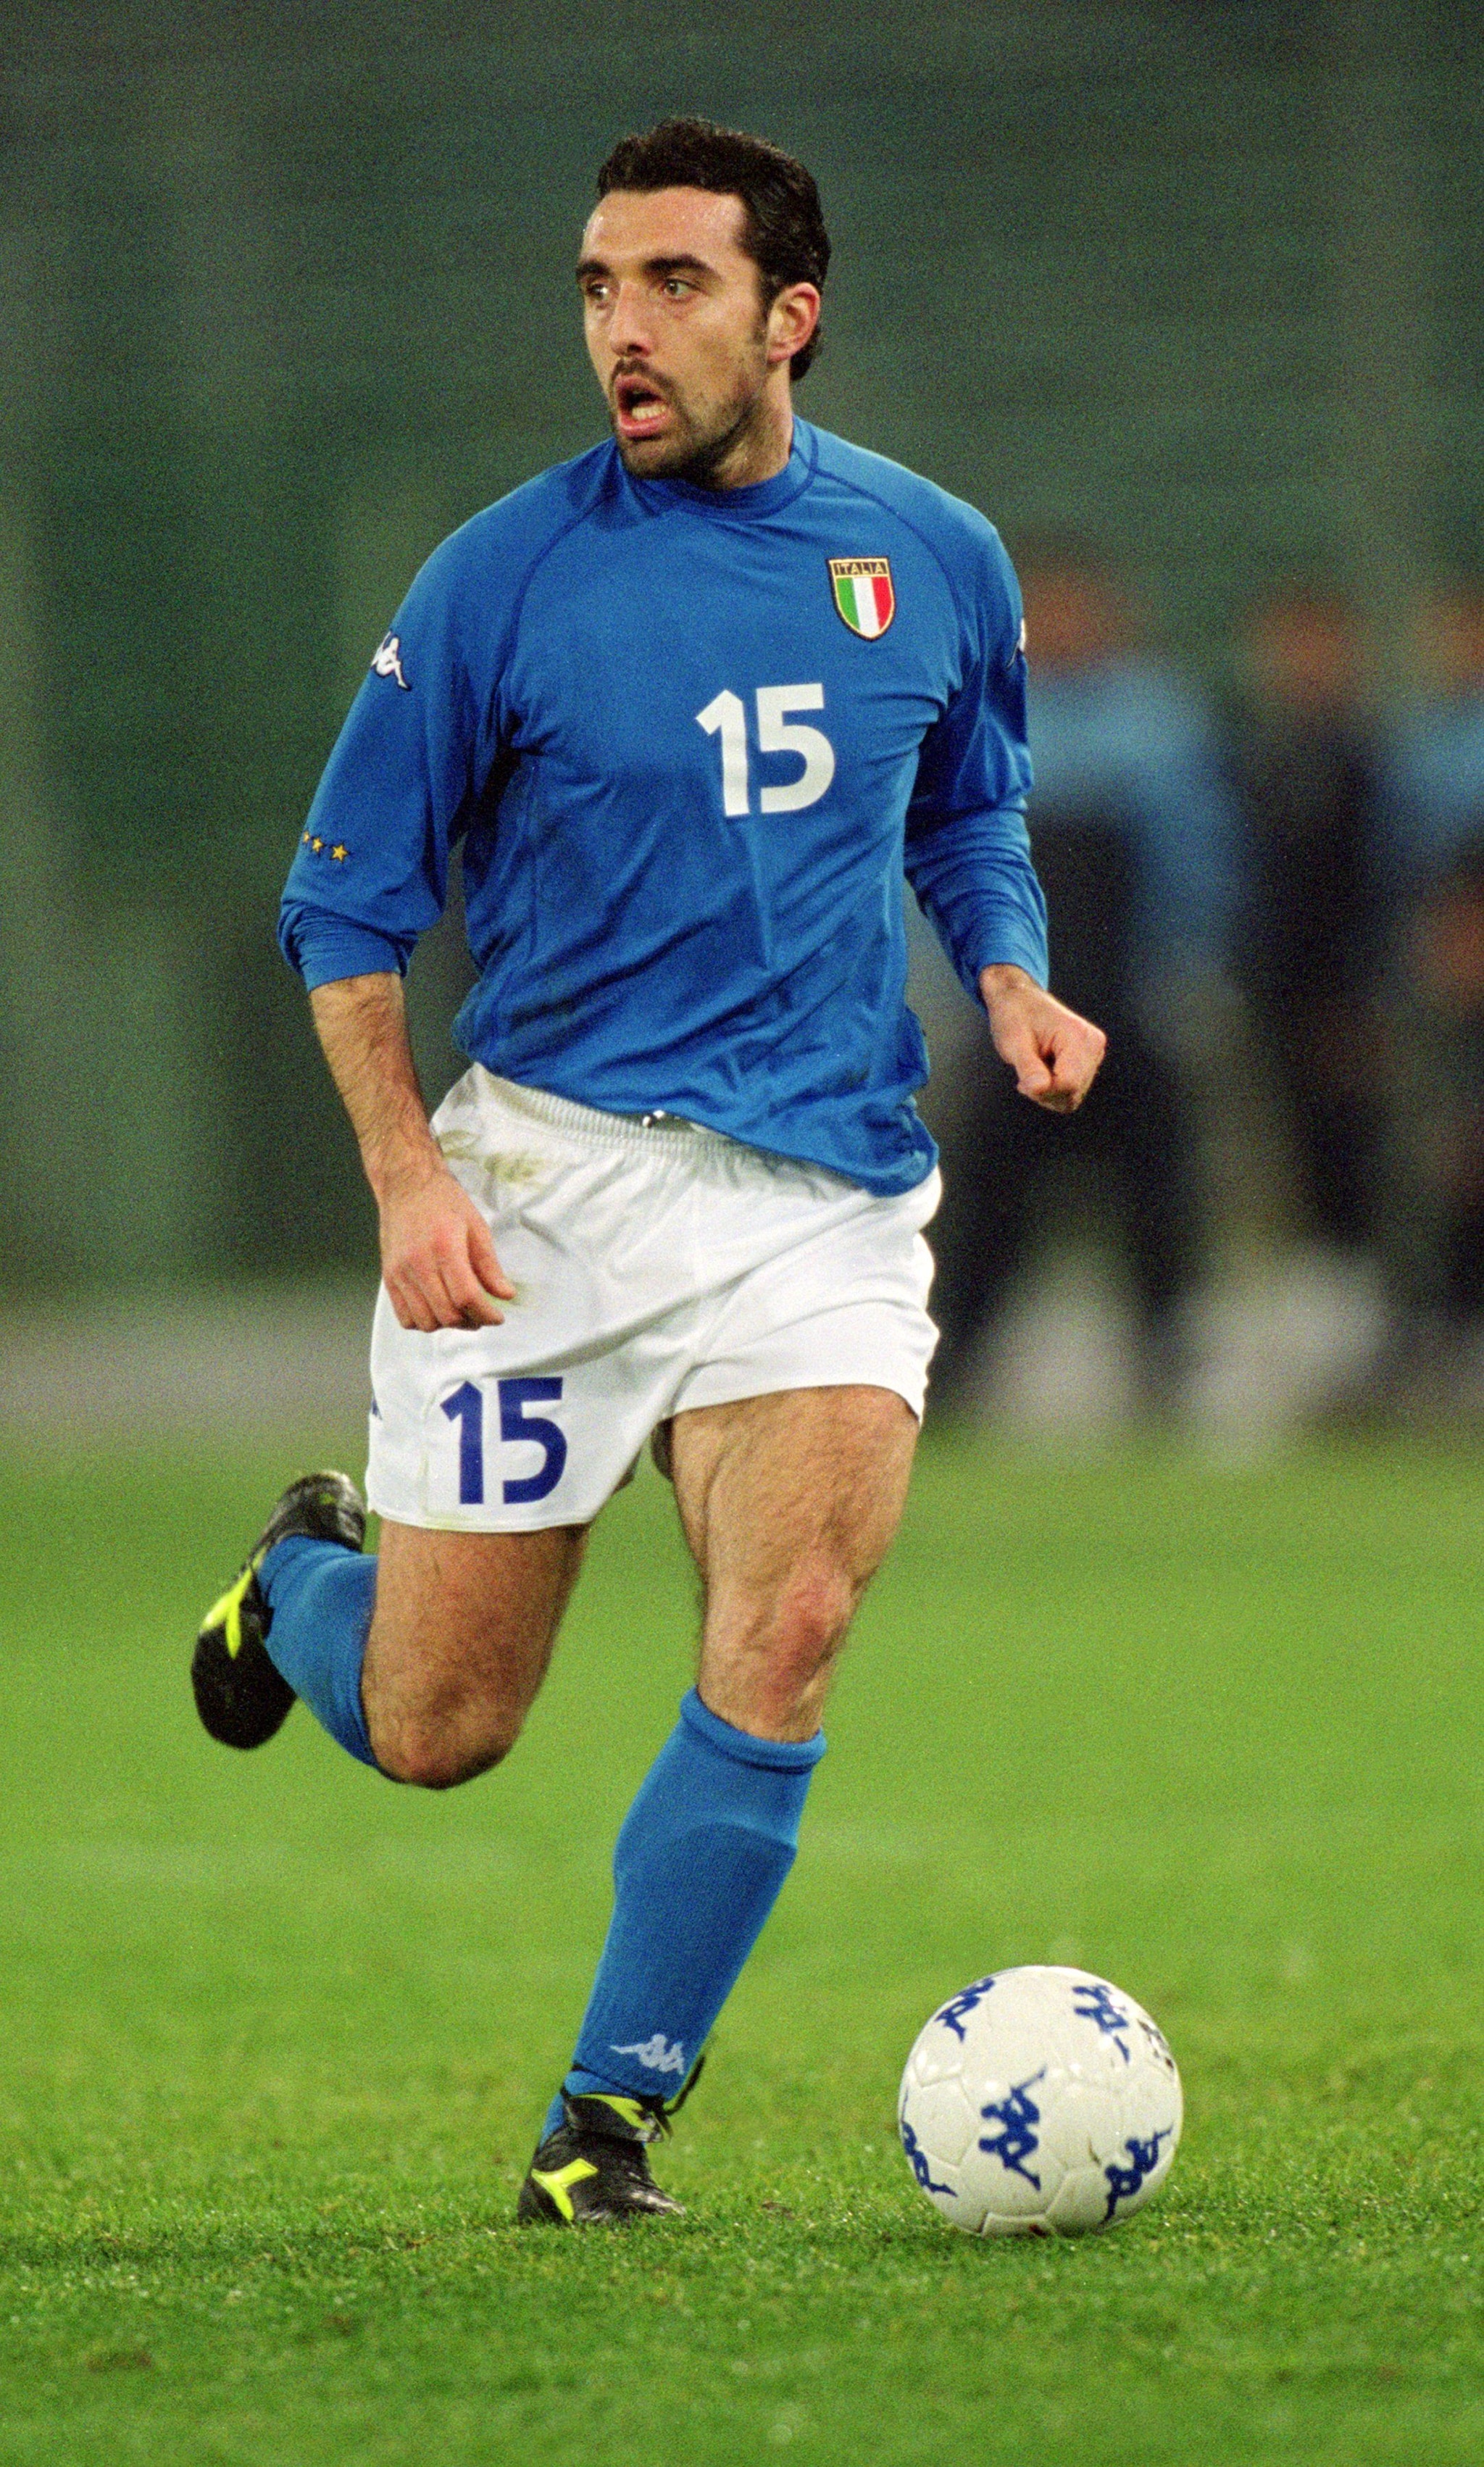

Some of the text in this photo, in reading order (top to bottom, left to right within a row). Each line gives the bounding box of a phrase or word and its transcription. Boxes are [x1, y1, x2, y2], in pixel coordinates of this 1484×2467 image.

[836, 562, 885, 574] ITALIA
[695, 683, 835, 817] 15
[440, 1376, 567, 1505] 15
